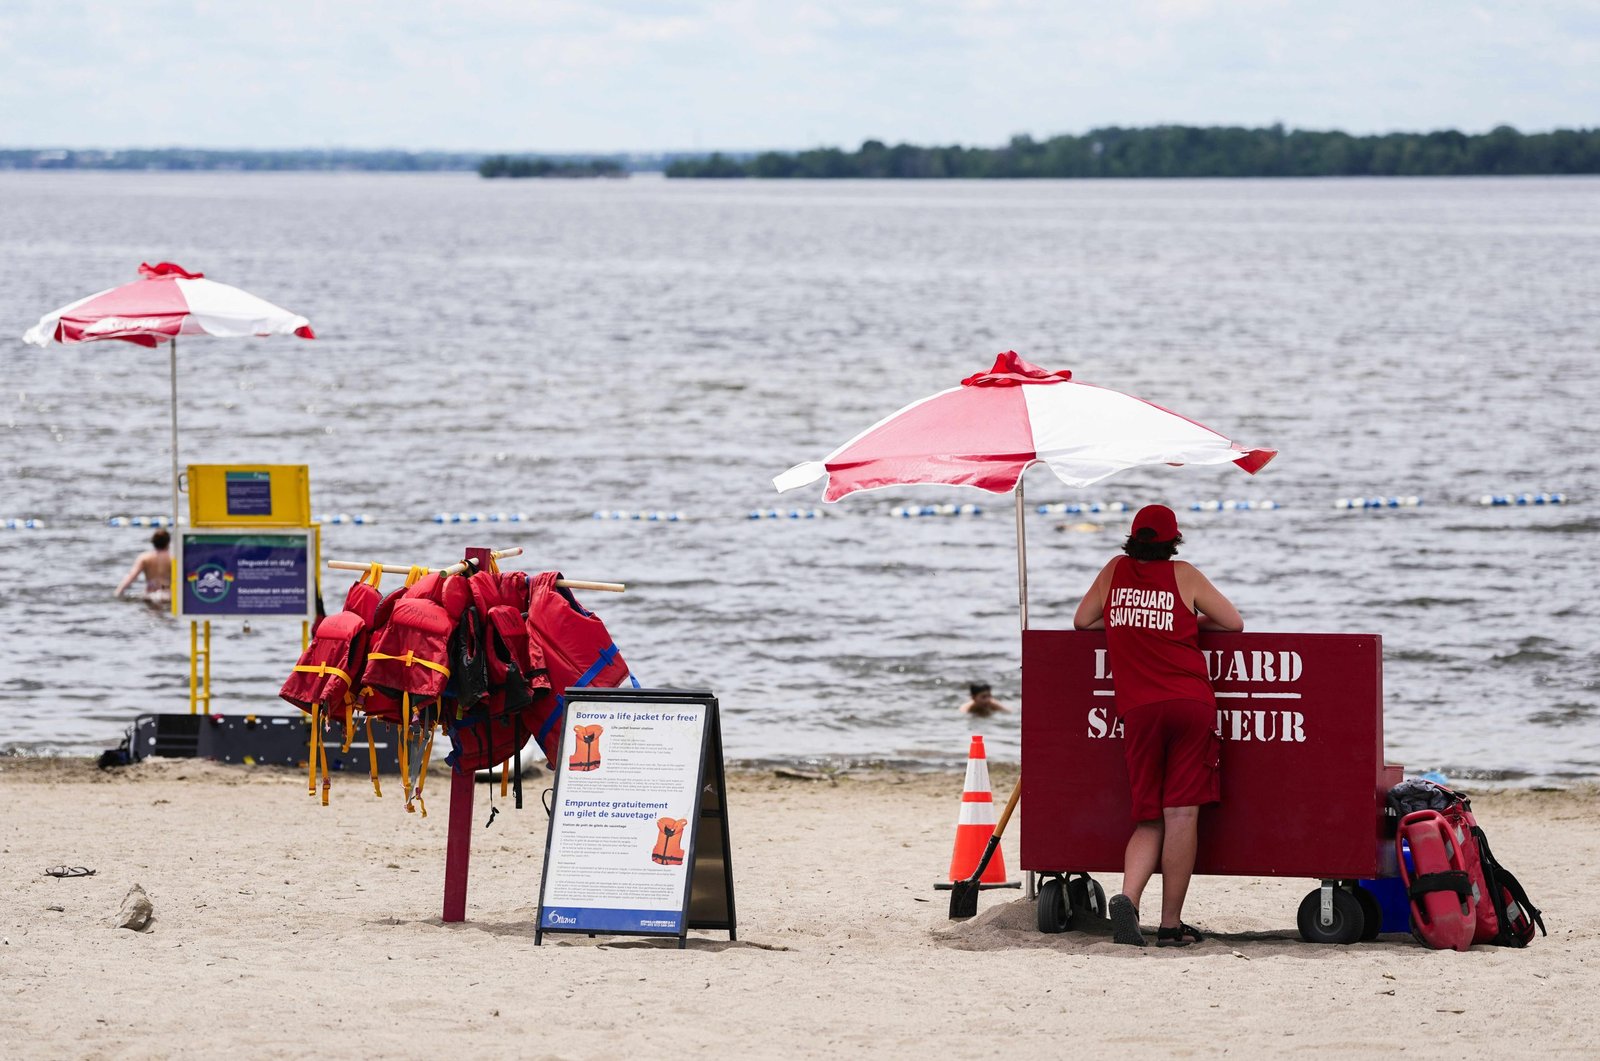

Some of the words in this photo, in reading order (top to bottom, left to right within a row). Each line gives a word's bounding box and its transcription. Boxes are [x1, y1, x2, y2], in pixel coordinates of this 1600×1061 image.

[237, 560, 268, 568] Lifeguard
[279, 560, 295, 568] duty
[1110, 588, 1174, 610] LIFEGUARD
[1110, 607, 1174, 631] SAUVETEUR
[1094, 649, 1303, 682] LUARD
[576, 712, 607, 720] Borrow
[617, 712, 631, 720] life
[632, 712, 659, 722] jacket
[676, 713, 698, 721] free!
[1088, 707, 1307, 742] SATEUR
[565, 799, 610, 808] Empruntez
[612, 800, 668, 810] gratuitement
[576, 810, 596, 818] gilet
[611, 812, 658, 820] sauvetage!
[548, 910, 576, 924] Ottawa
